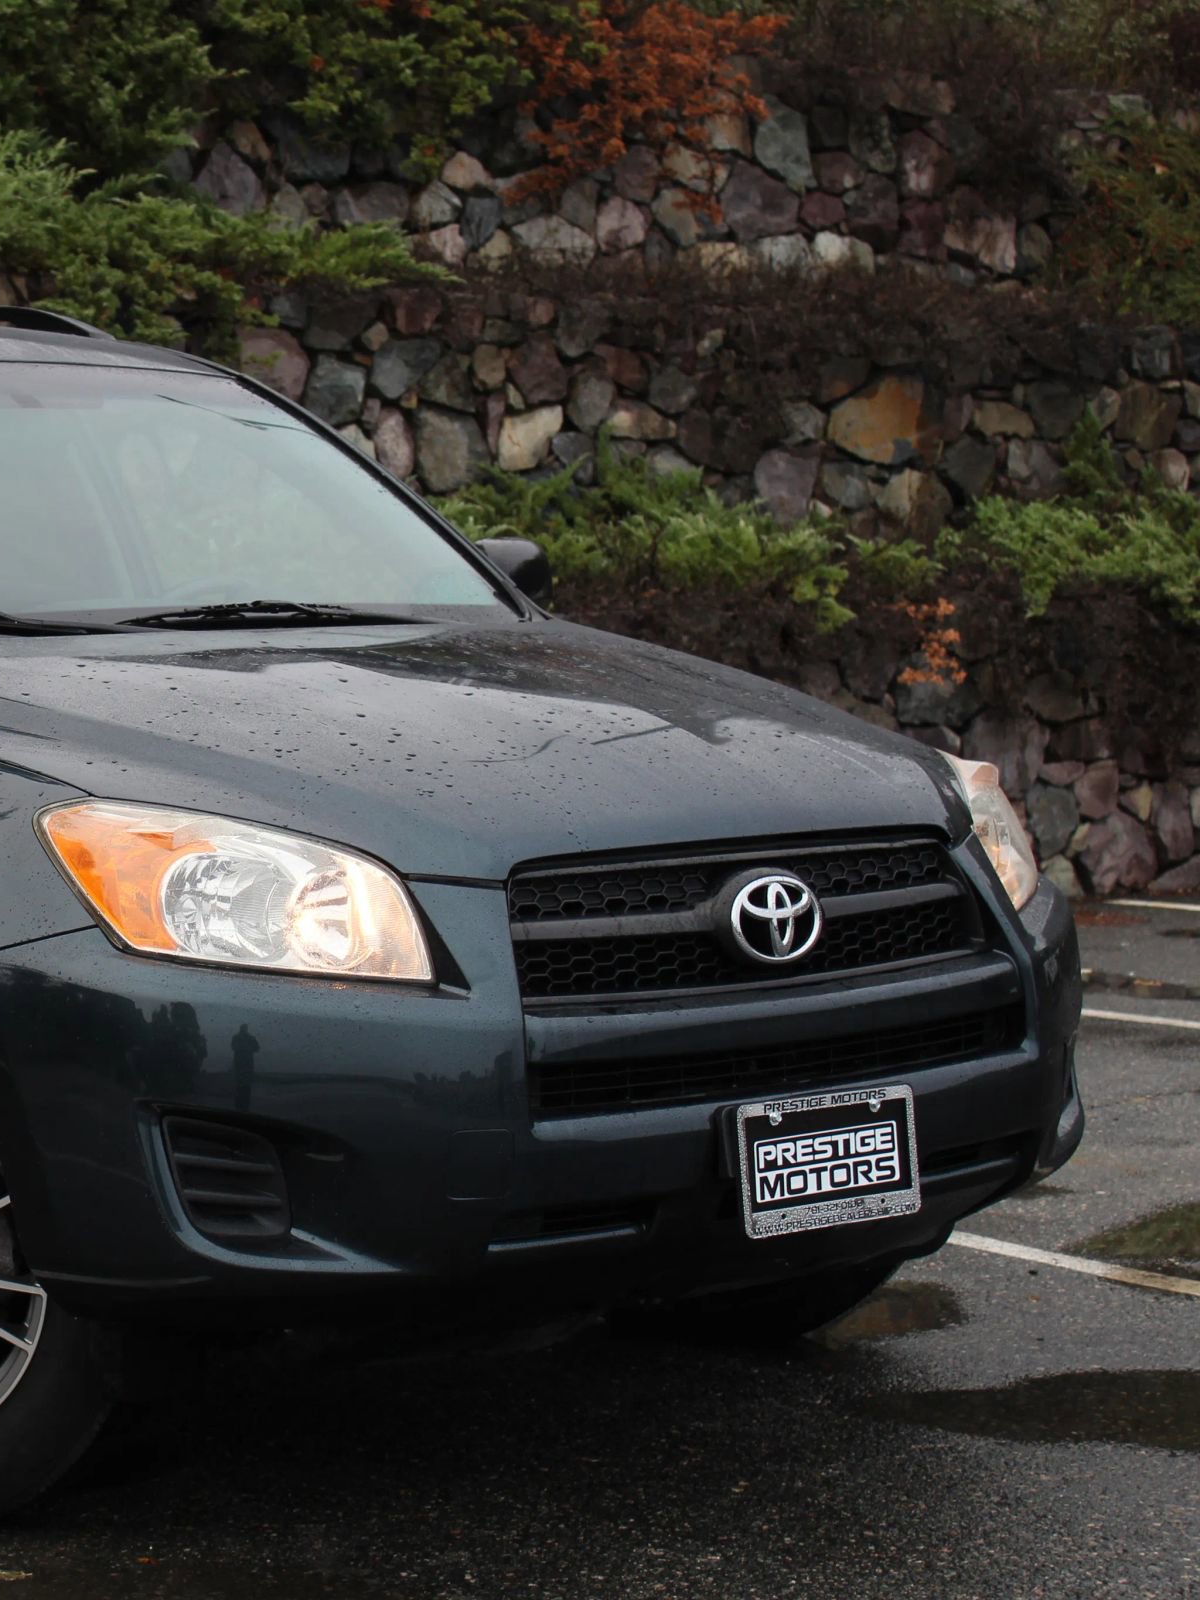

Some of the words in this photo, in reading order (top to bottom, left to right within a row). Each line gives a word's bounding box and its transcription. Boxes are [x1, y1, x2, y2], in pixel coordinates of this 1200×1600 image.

[763, 1096, 827, 1114] PRESTIGE
[831, 1088, 887, 1106] MOTORS
[758, 1126, 894, 1170] PRESTIGE
[759, 1156, 897, 1201] MOTORS
